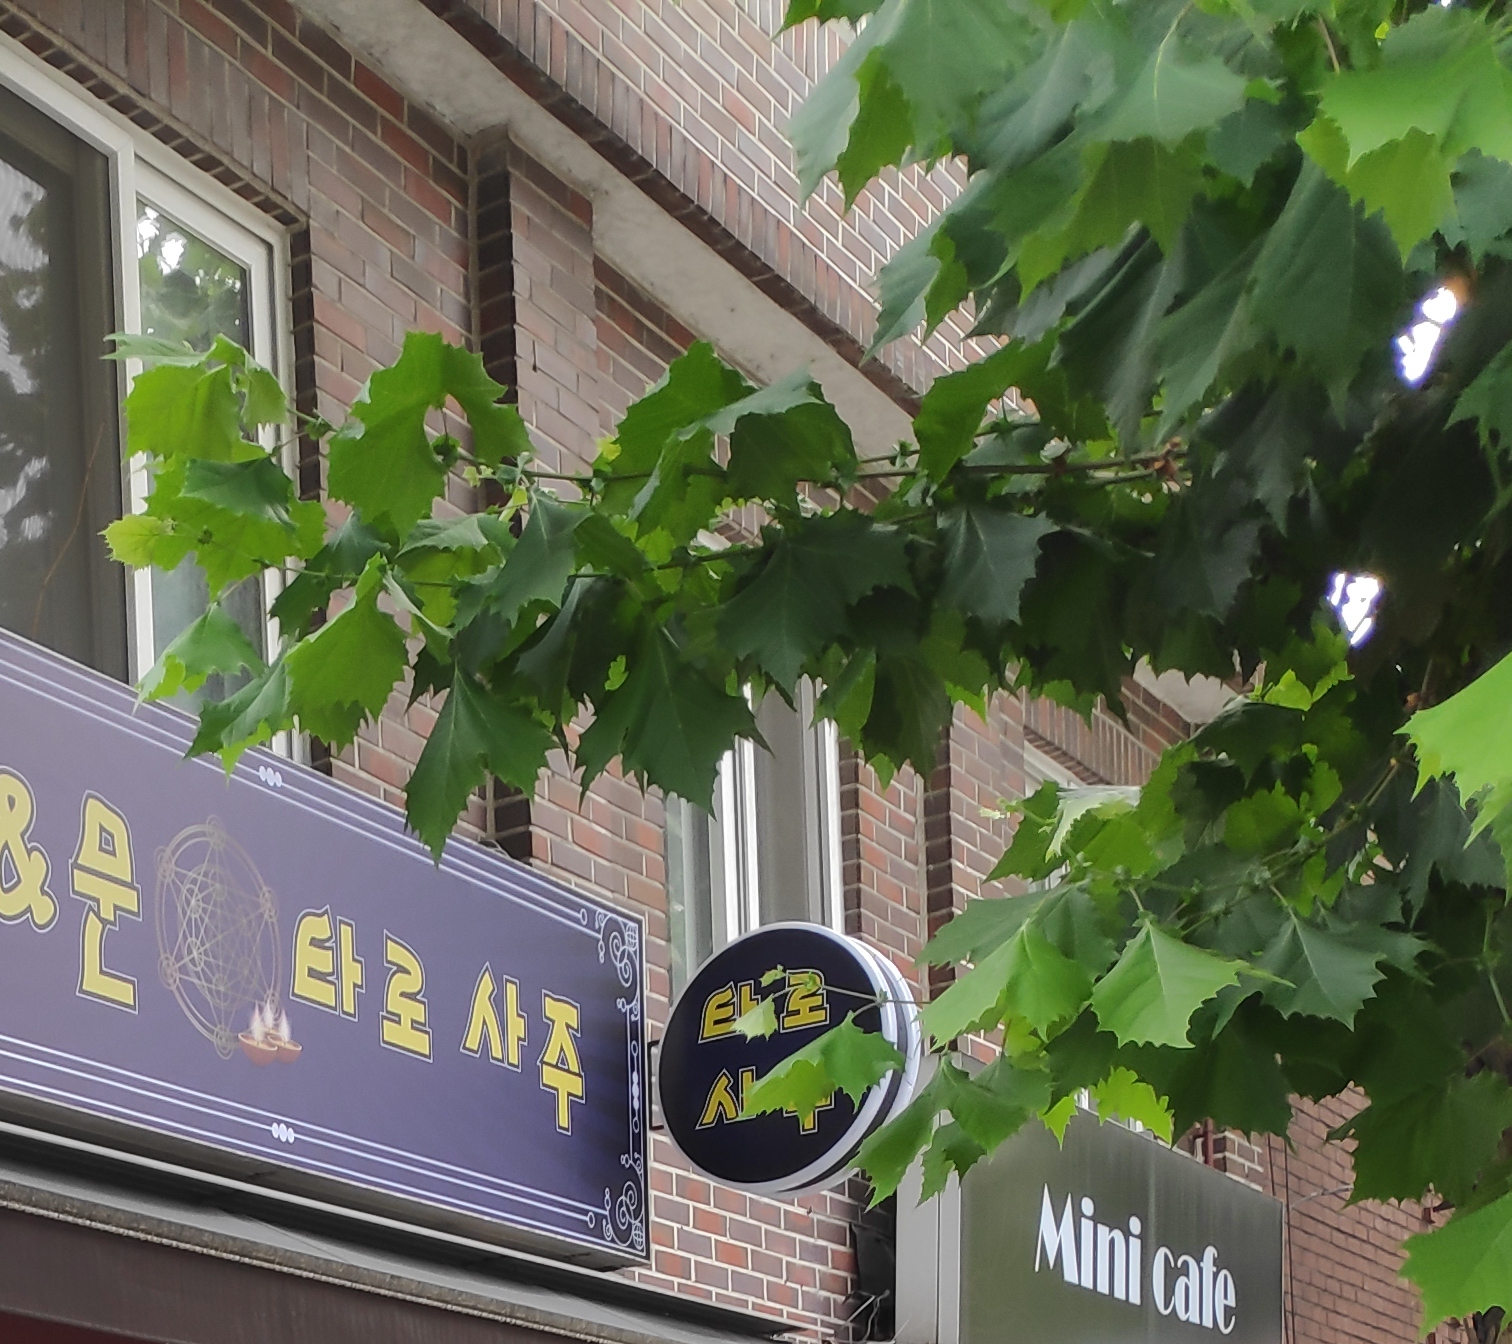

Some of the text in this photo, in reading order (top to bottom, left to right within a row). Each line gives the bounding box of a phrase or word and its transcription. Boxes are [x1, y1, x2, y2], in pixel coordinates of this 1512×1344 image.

[290, 905, 433, 1063] 타로
[460, 961, 585, 1136] 사주
[1034, 1182, 1236, 1335] Mini cafe
